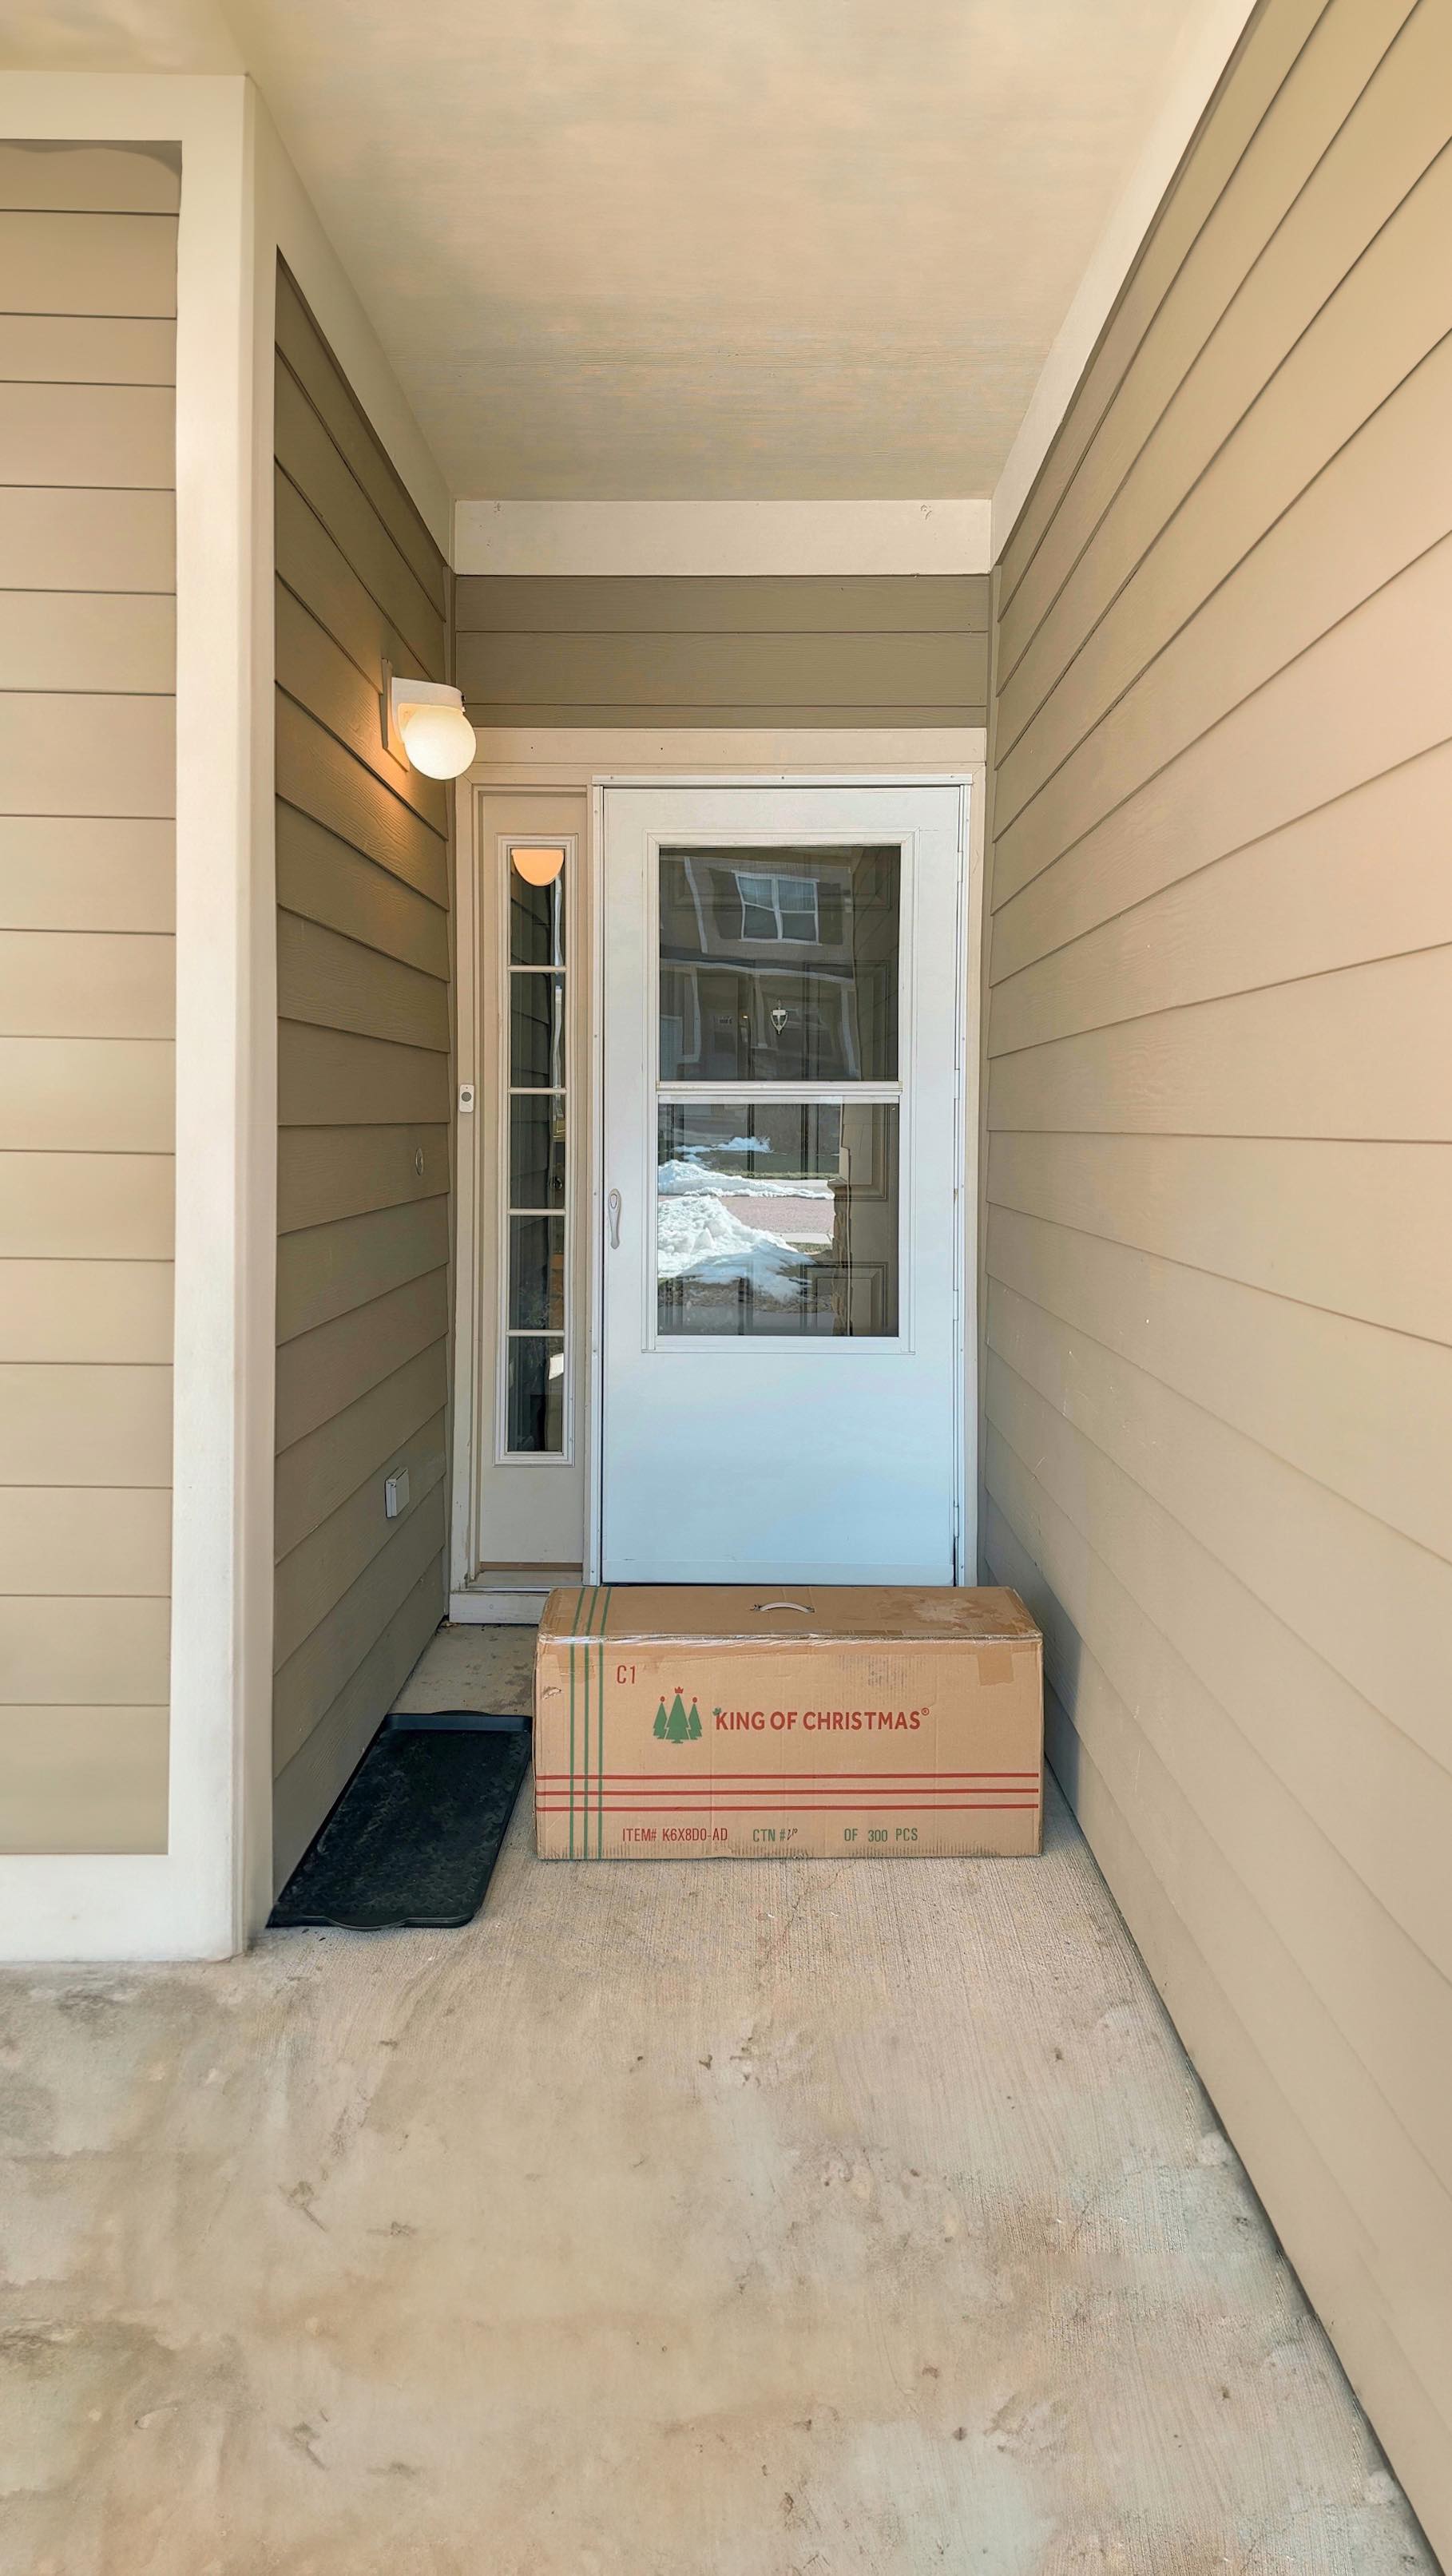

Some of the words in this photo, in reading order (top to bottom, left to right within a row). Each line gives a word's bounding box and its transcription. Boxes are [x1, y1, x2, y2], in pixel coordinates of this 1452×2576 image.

[617, 1665, 636, 1684] C1
[716, 1710, 765, 1730] KING
[770, 1711, 798, 1730] OF
[622, 1828, 657, 1841] ITEM#
[752, 1829, 776, 1842] CTN
[844, 1828, 858, 1841] OF
[868, 1829, 888, 1842] 300
[895, 1828, 918, 1841] PCS
